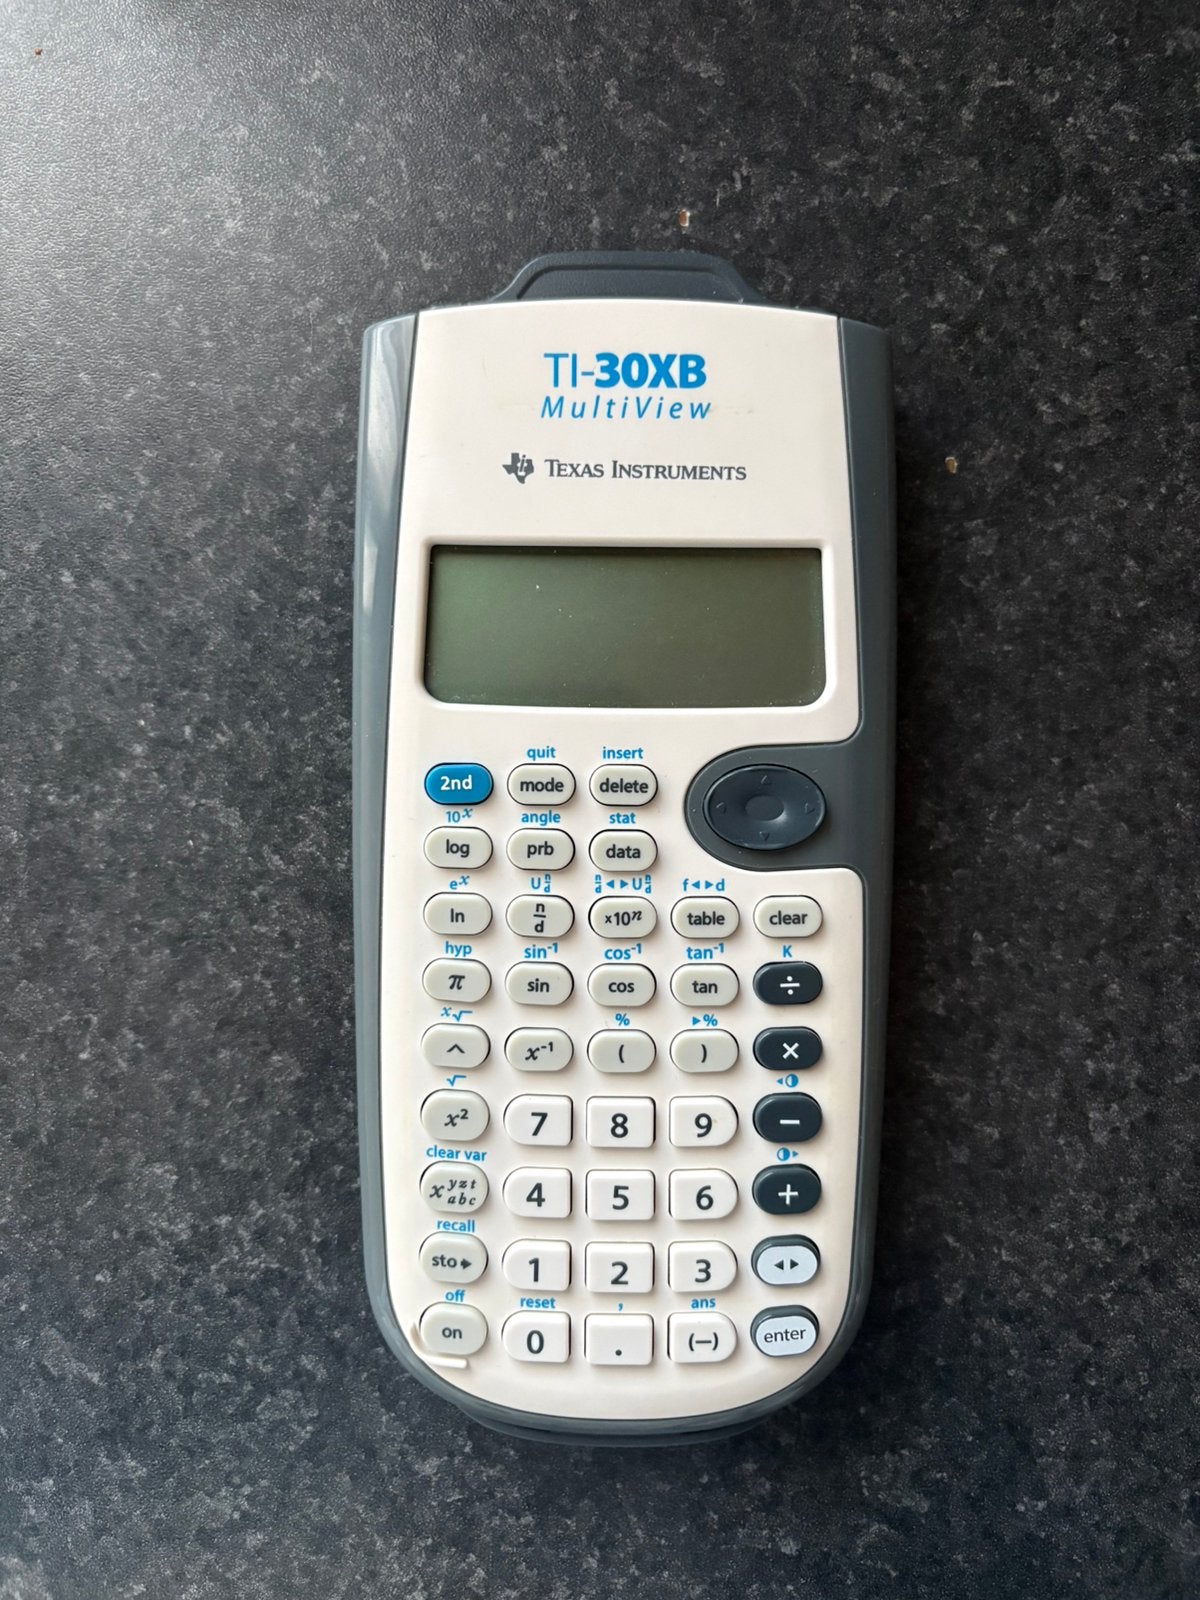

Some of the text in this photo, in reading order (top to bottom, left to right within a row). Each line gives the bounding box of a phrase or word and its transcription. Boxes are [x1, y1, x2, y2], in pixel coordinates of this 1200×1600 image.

[544, 352, 707, 389] TI-30XB
[540, 395, 712, 418] MultiView
[544, 459, 604, 478] TEXAS
[611, 460, 747, 481] INSTRUMENTS
[527, 746, 556, 760] quit
[602, 747, 643, 759] insert
[440, 775, 473, 791] 2nd
[520, 778, 564, 792] mode
[599, 778, 648, 793] delete
[521, 811, 561, 826] angle
[609, 812, 636, 824] stat
[446, 839, 470, 858] log
[527, 841, 554, 858] prb
[606, 845, 641, 859] data
[450, 908, 465, 923] ln
[687, 911, 725, 926] table
[769, 910, 808, 925] clear
[445, 941, 472, 957] hyp
[782, 945, 792, 958] K
[527, 978, 550, 993] sin
[608, 981, 635, 993] cos
[692, 980, 718, 994] tan
[615, 1013, 630, 1026] %
[531, 1112, 548, 1136] 7
[610, 1113, 629, 1138] 8
[694, 1113, 713, 1138] 9
[426, 1145, 487, 1161] clear var
[526, 1182, 546, 1207] 4
[612, 1185, 629, 1210] 5
[696, 1185, 714, 1210] 6
[437, 1219, 475, 1233] recall
[432, 1254, 457, 1269] sto
[528, 1257, 540, 1283] 1
[610, 1261, 629, 1285] 2
[695, 1259, 712, 1283] 3
[445, 1289, 465, 1302] off
[520, 1296, 556, 1309] reset
[691, 1297, 716, 1309] ans
[442, 1326, 463, 1339] on
[764, 1328, 806, 1343] enter
[526, 1329, 544, 1355] 0
